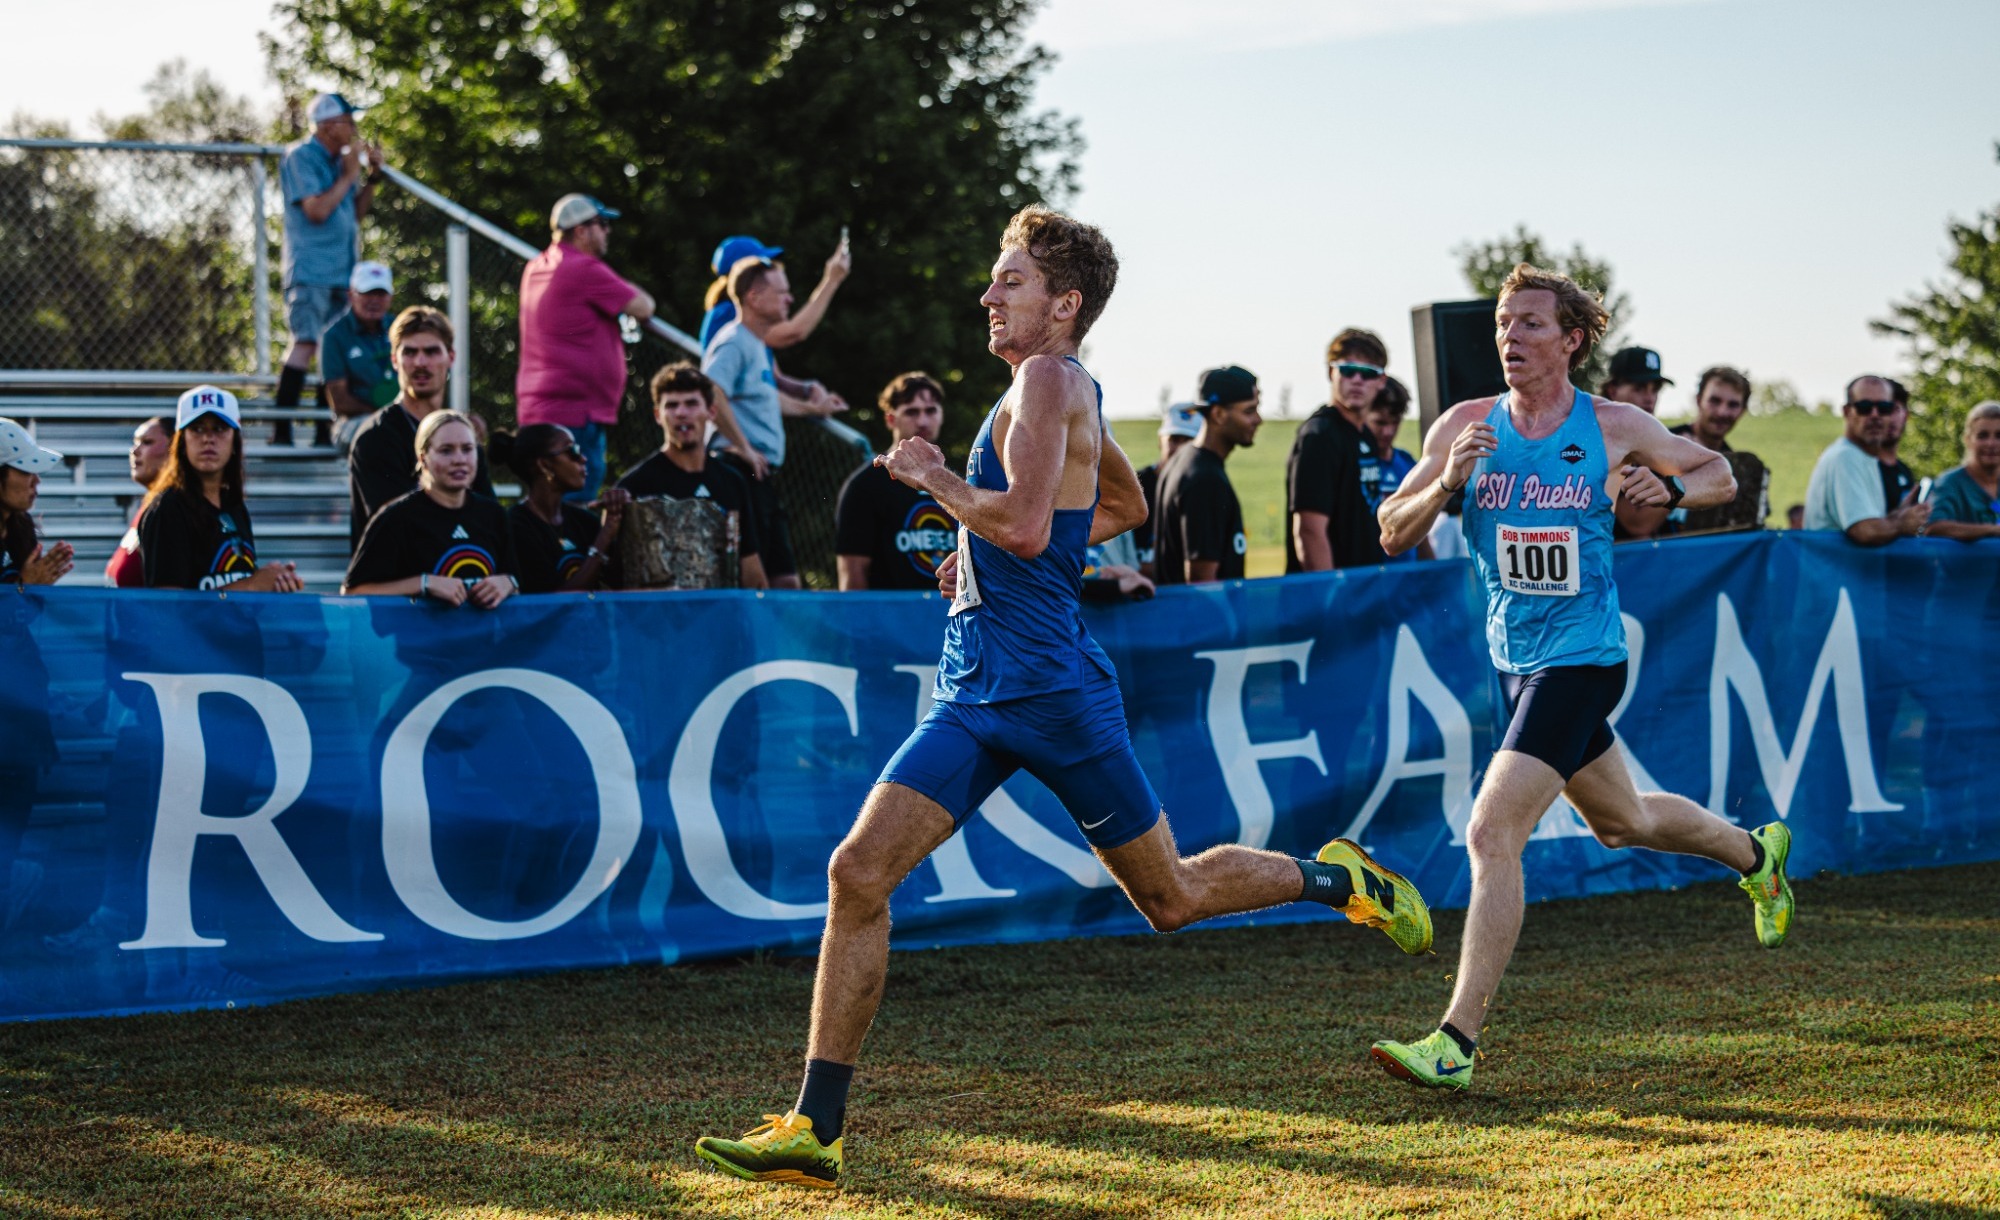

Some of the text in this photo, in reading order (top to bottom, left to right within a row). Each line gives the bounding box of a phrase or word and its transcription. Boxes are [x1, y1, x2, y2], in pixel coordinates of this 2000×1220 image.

[1561, 451, 1585, 459] RMAC
[1476, 472, 1592, 510] CSU Pueblo
[1502, 529, 1570, 543] BOB TIMMONS
[1506, 544, 1568, 581] 100
[1509, 580, 1569, 592] XC CHALLENGE
[118, 659, 1117, 951] ROCK
